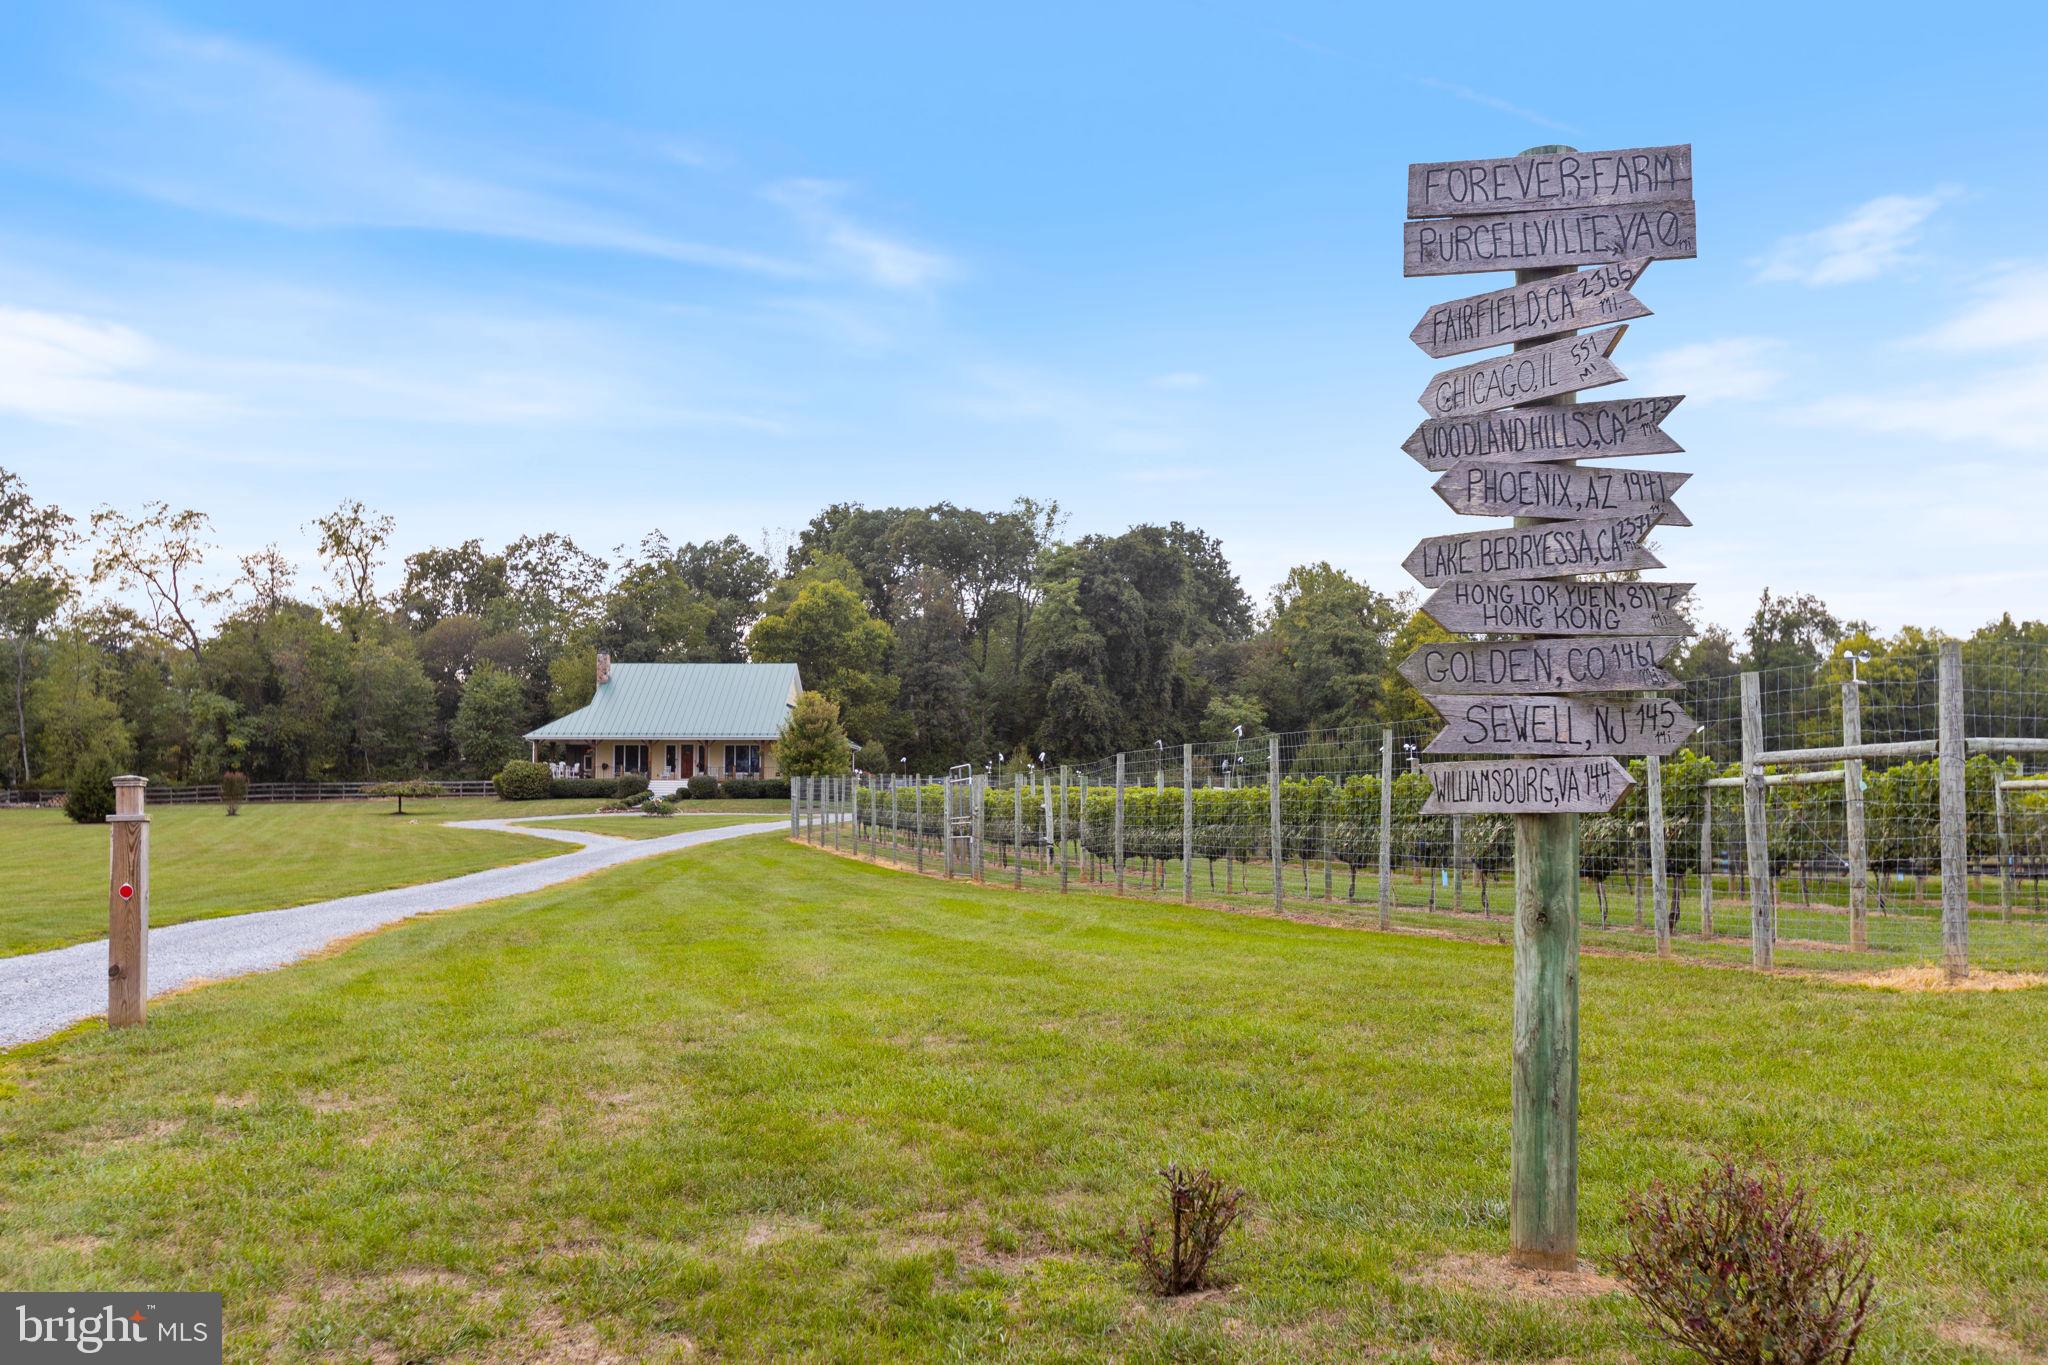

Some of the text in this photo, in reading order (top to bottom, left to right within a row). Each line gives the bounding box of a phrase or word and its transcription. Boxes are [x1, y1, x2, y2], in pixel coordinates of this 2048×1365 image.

[1425, 153, 1675, 205] FOREVER-FARM
[1578, 264, 1632, 298] 2366
[1570, 335, 1597, 366] 551
[1622, 397, 1672, 424] 2273
[1587, 475, 1617, 509] AZ
[1622, 472, 1666, 502] 1941
[1422, 539, 1473, 577] LAKE
[1455, 585, 1678, 612] HONG LOK YUEN, 8117
[1483, 604, 1621, 630] HONG KONG
[1611, 640, 1658, 668] 1461
[1595, 704, 1627, 744] NJ
[1636, 701, 1675, 735] 145
[1585, 762, 1610, 796] 144
